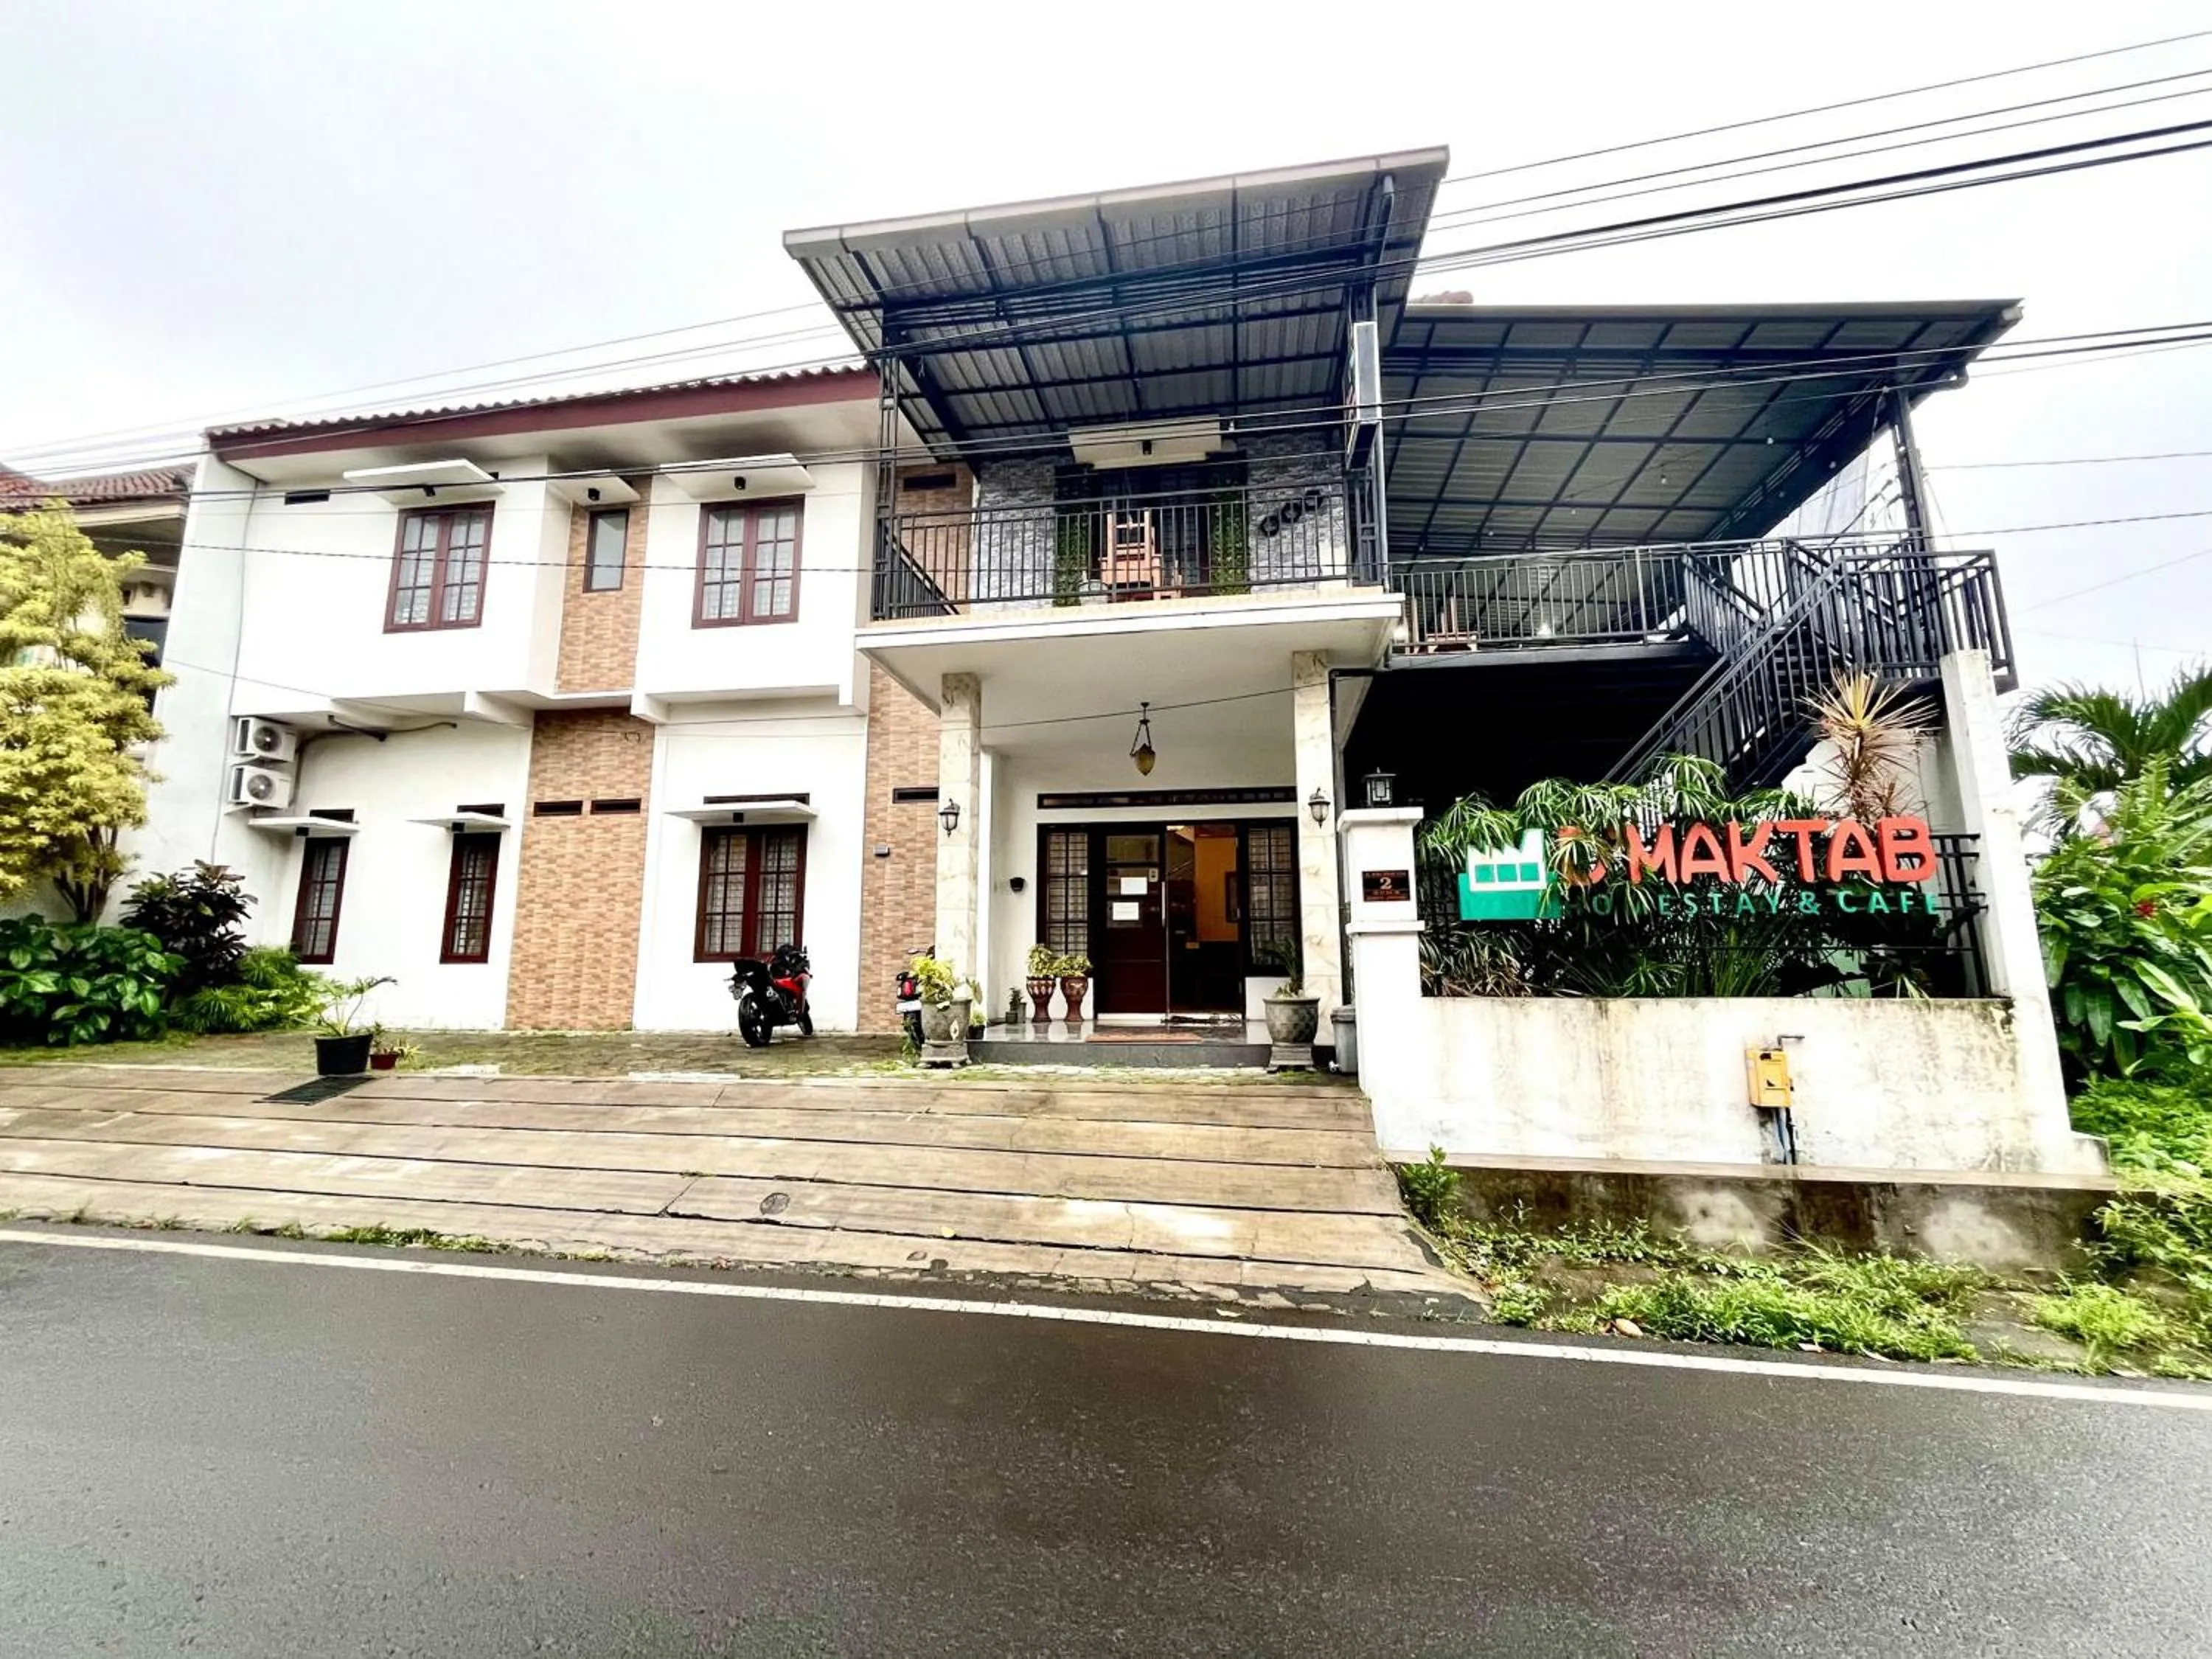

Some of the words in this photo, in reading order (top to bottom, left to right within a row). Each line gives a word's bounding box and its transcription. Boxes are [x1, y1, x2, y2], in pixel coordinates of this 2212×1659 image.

[1380, 877, 1393, 890] 2
[1797, 891, 1821, 915] &
[1837, 889, 1940, 915] CAFE
